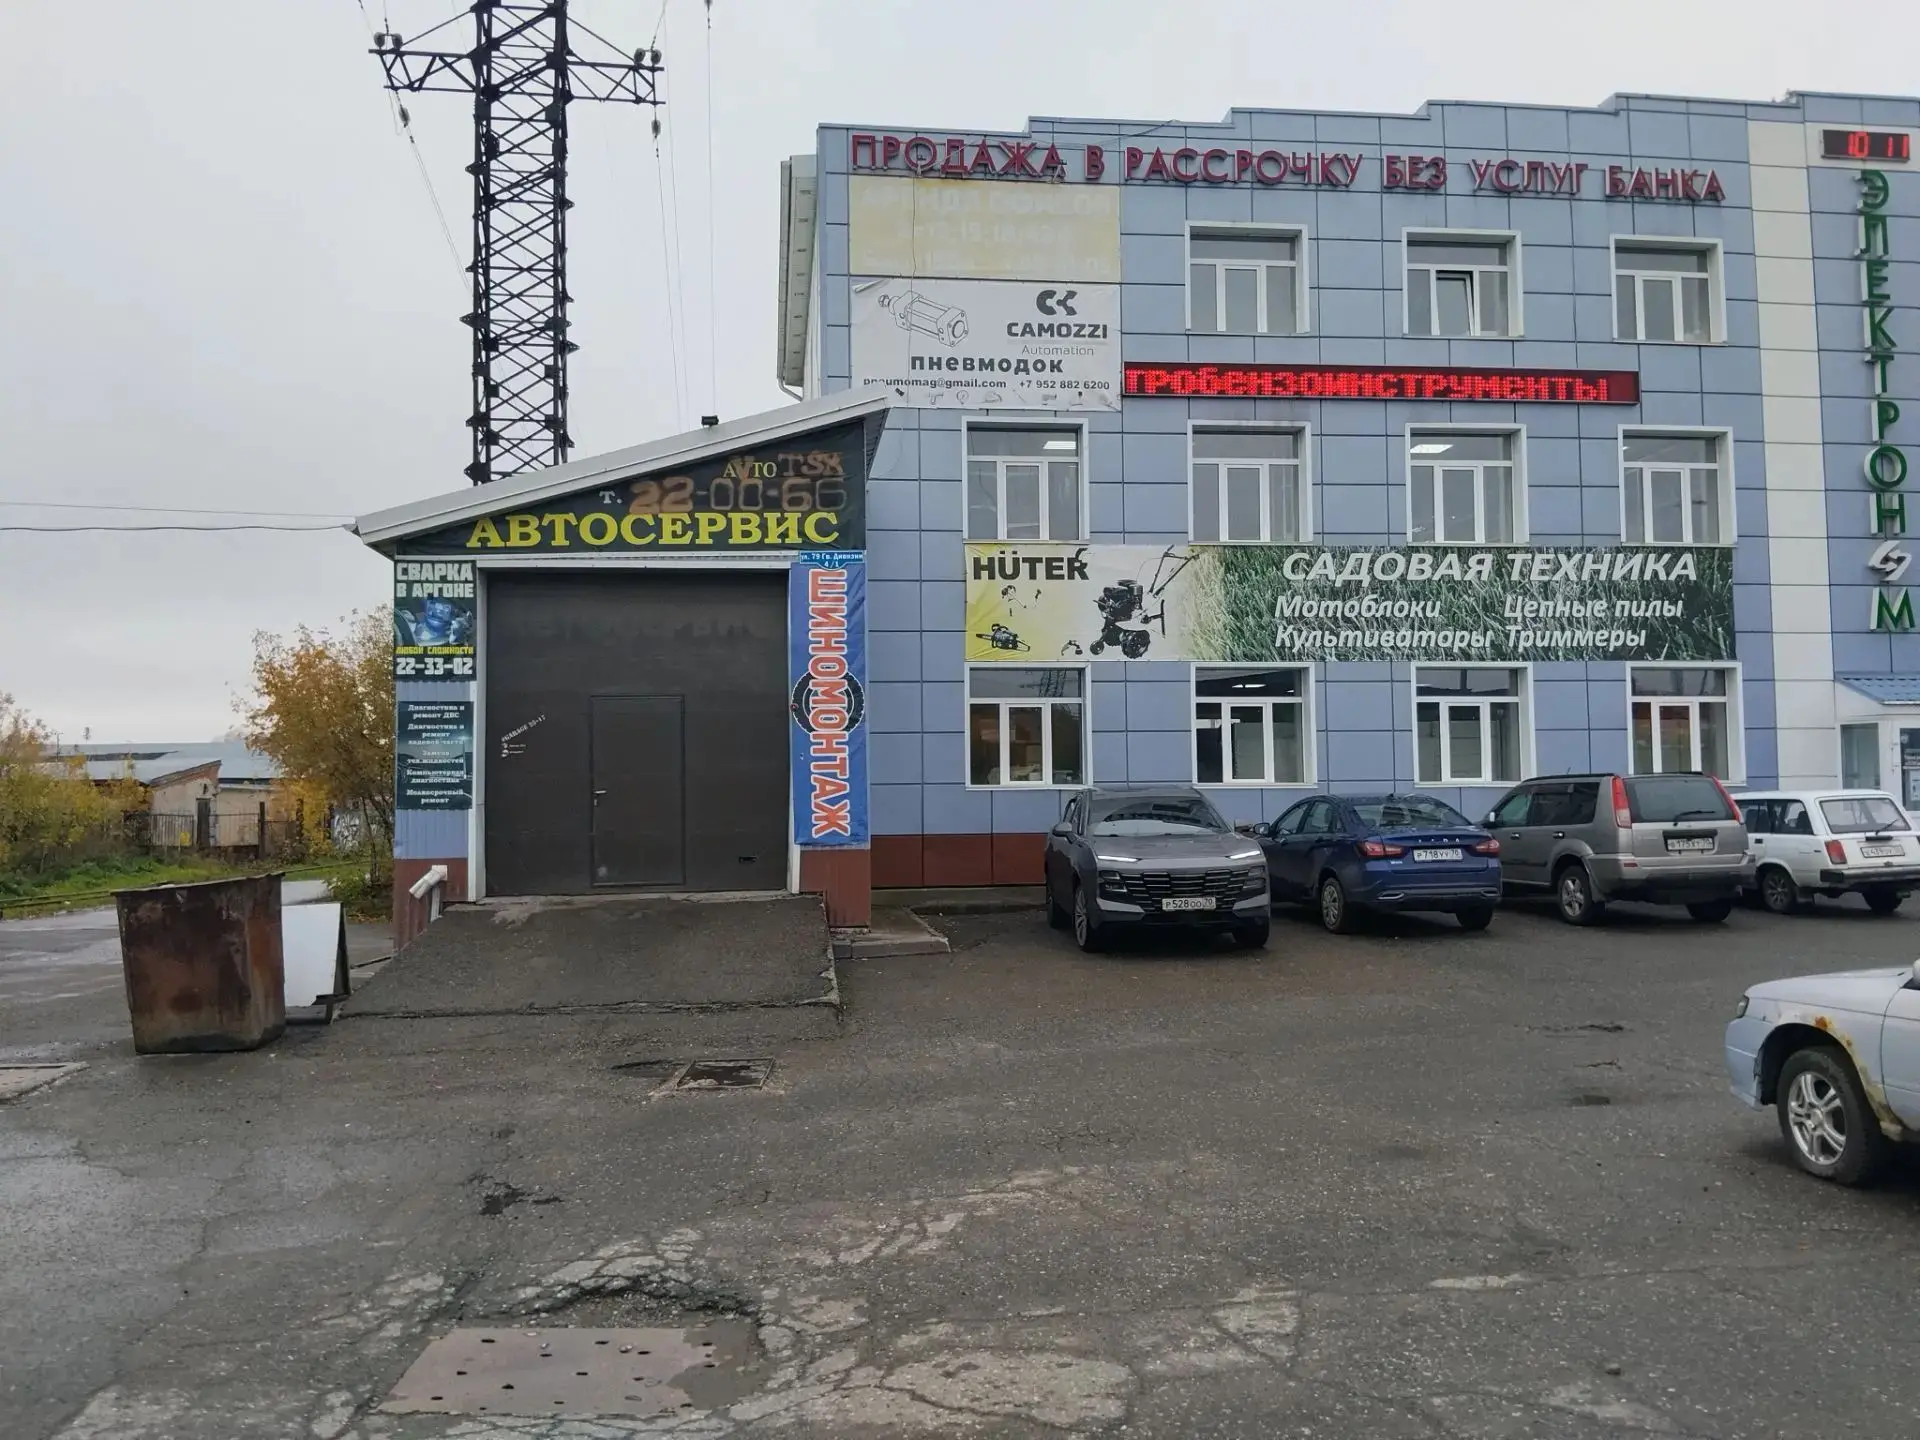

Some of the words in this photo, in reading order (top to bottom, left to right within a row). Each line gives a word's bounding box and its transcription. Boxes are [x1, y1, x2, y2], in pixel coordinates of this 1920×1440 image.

[851, 134, 1068, 178] ПРОДАЖА
[1085, 145, 1105, 180] В
[1125, 146, 1363, 187] РАССРОЧКУ
[1383, 155, 1448, 190] БЕЗ
[1469, 158, 1588, 195] УСЛУГ
[1605, 166, 1725, 201] БАНКА
[1006, 322, 1108, 339] CAMOZZI
[1021, 344, 1094, 357] Automation
[1019, 379, 1033, 389] +7
[1036, 380, 1056, 389] 952
[1060, 380, 1080, 390] 882
[1083, 380, 1110, 390] 6200
[466, 510, 840, 549] АВТОСЕРВИС
[396, 562, 474, 581] СВАРКА
[973, 550, 1089, 581] HÜTER
[1282, 553, 1493, 587] САДОВАЯ
[1506, 554, 1698, 582] ТЕХНИКА
[396, 583, 407, 598] В
[412, 583, 474, 598] АРГОНЕ
[1274, 595, 1441, 618] Мотоблоки
[1504, 596, 1606, 620] Цепные
[1614, 599, 1683, 618] пилы
[1274, 625, 1493, 651] Культиваторы
[1507, 626, 1647, 648] Триммеры
[396, 657, 473, 675] 22-33-02
[808, 568, 850, 839] ШИНОМОНТАЖ
